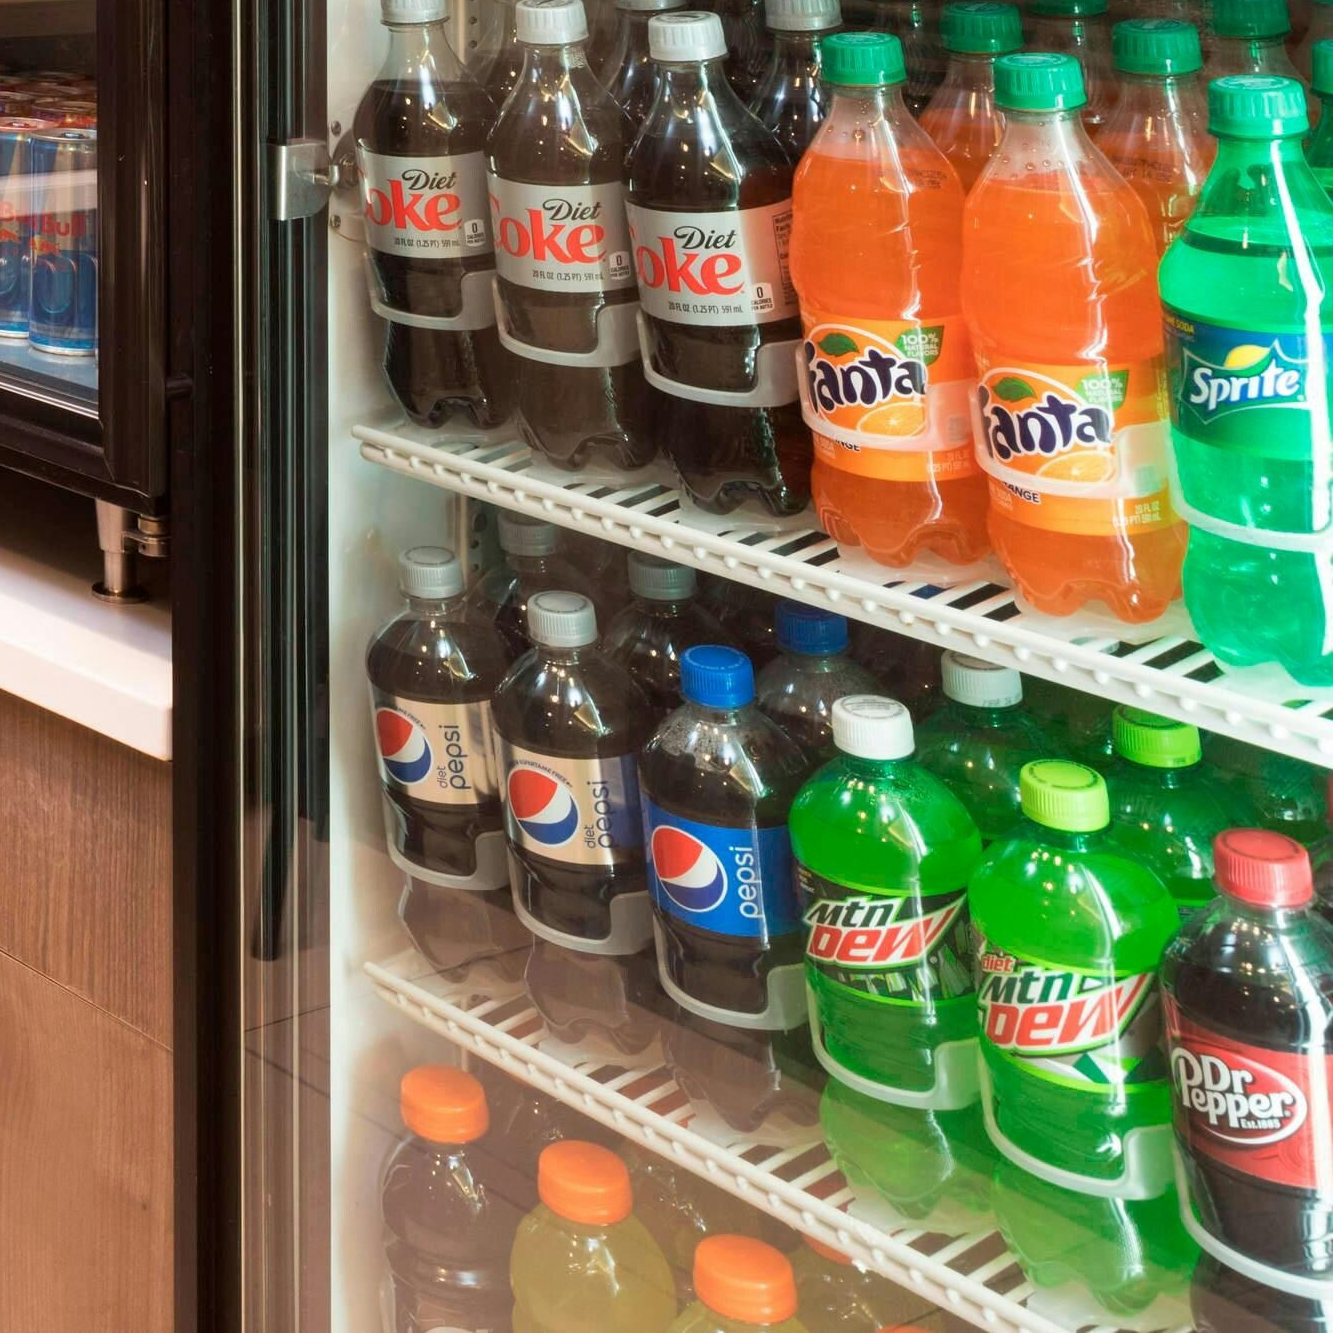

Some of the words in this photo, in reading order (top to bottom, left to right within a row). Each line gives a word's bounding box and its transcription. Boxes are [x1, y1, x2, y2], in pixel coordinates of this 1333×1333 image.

[402, 169, 457, 190] Diet
[365, 179, 462, 232] oke
[543, 199, 601, 221] Diet
[41, 213, 84, 237] Bull
[491, 196, 606, 264] oke
[674, 225, 737, 250] Diet
[635, 236, 745, 296] oke
[757, 287, 763, 298] 0
[901, 333, 939, 343] 100%
[1176, 319, 1195, 334] SODA
[1190, 358, 1301, 411] Sprite
[1003, 481, 1040, 503] ANGE
[439, 725, 472, 790] pepsi
[437, 766, 447, 788] diet
[587, 780, 613, 849] pepsi
[585, 826, 596, 848] diet
[729, 845, 764, 919] pepsi
[981, 955, 1012, 972] diet
[1200, 1054, 1253, 1093] Dr
[1171, 1048, 1294, 1128] Pepper
